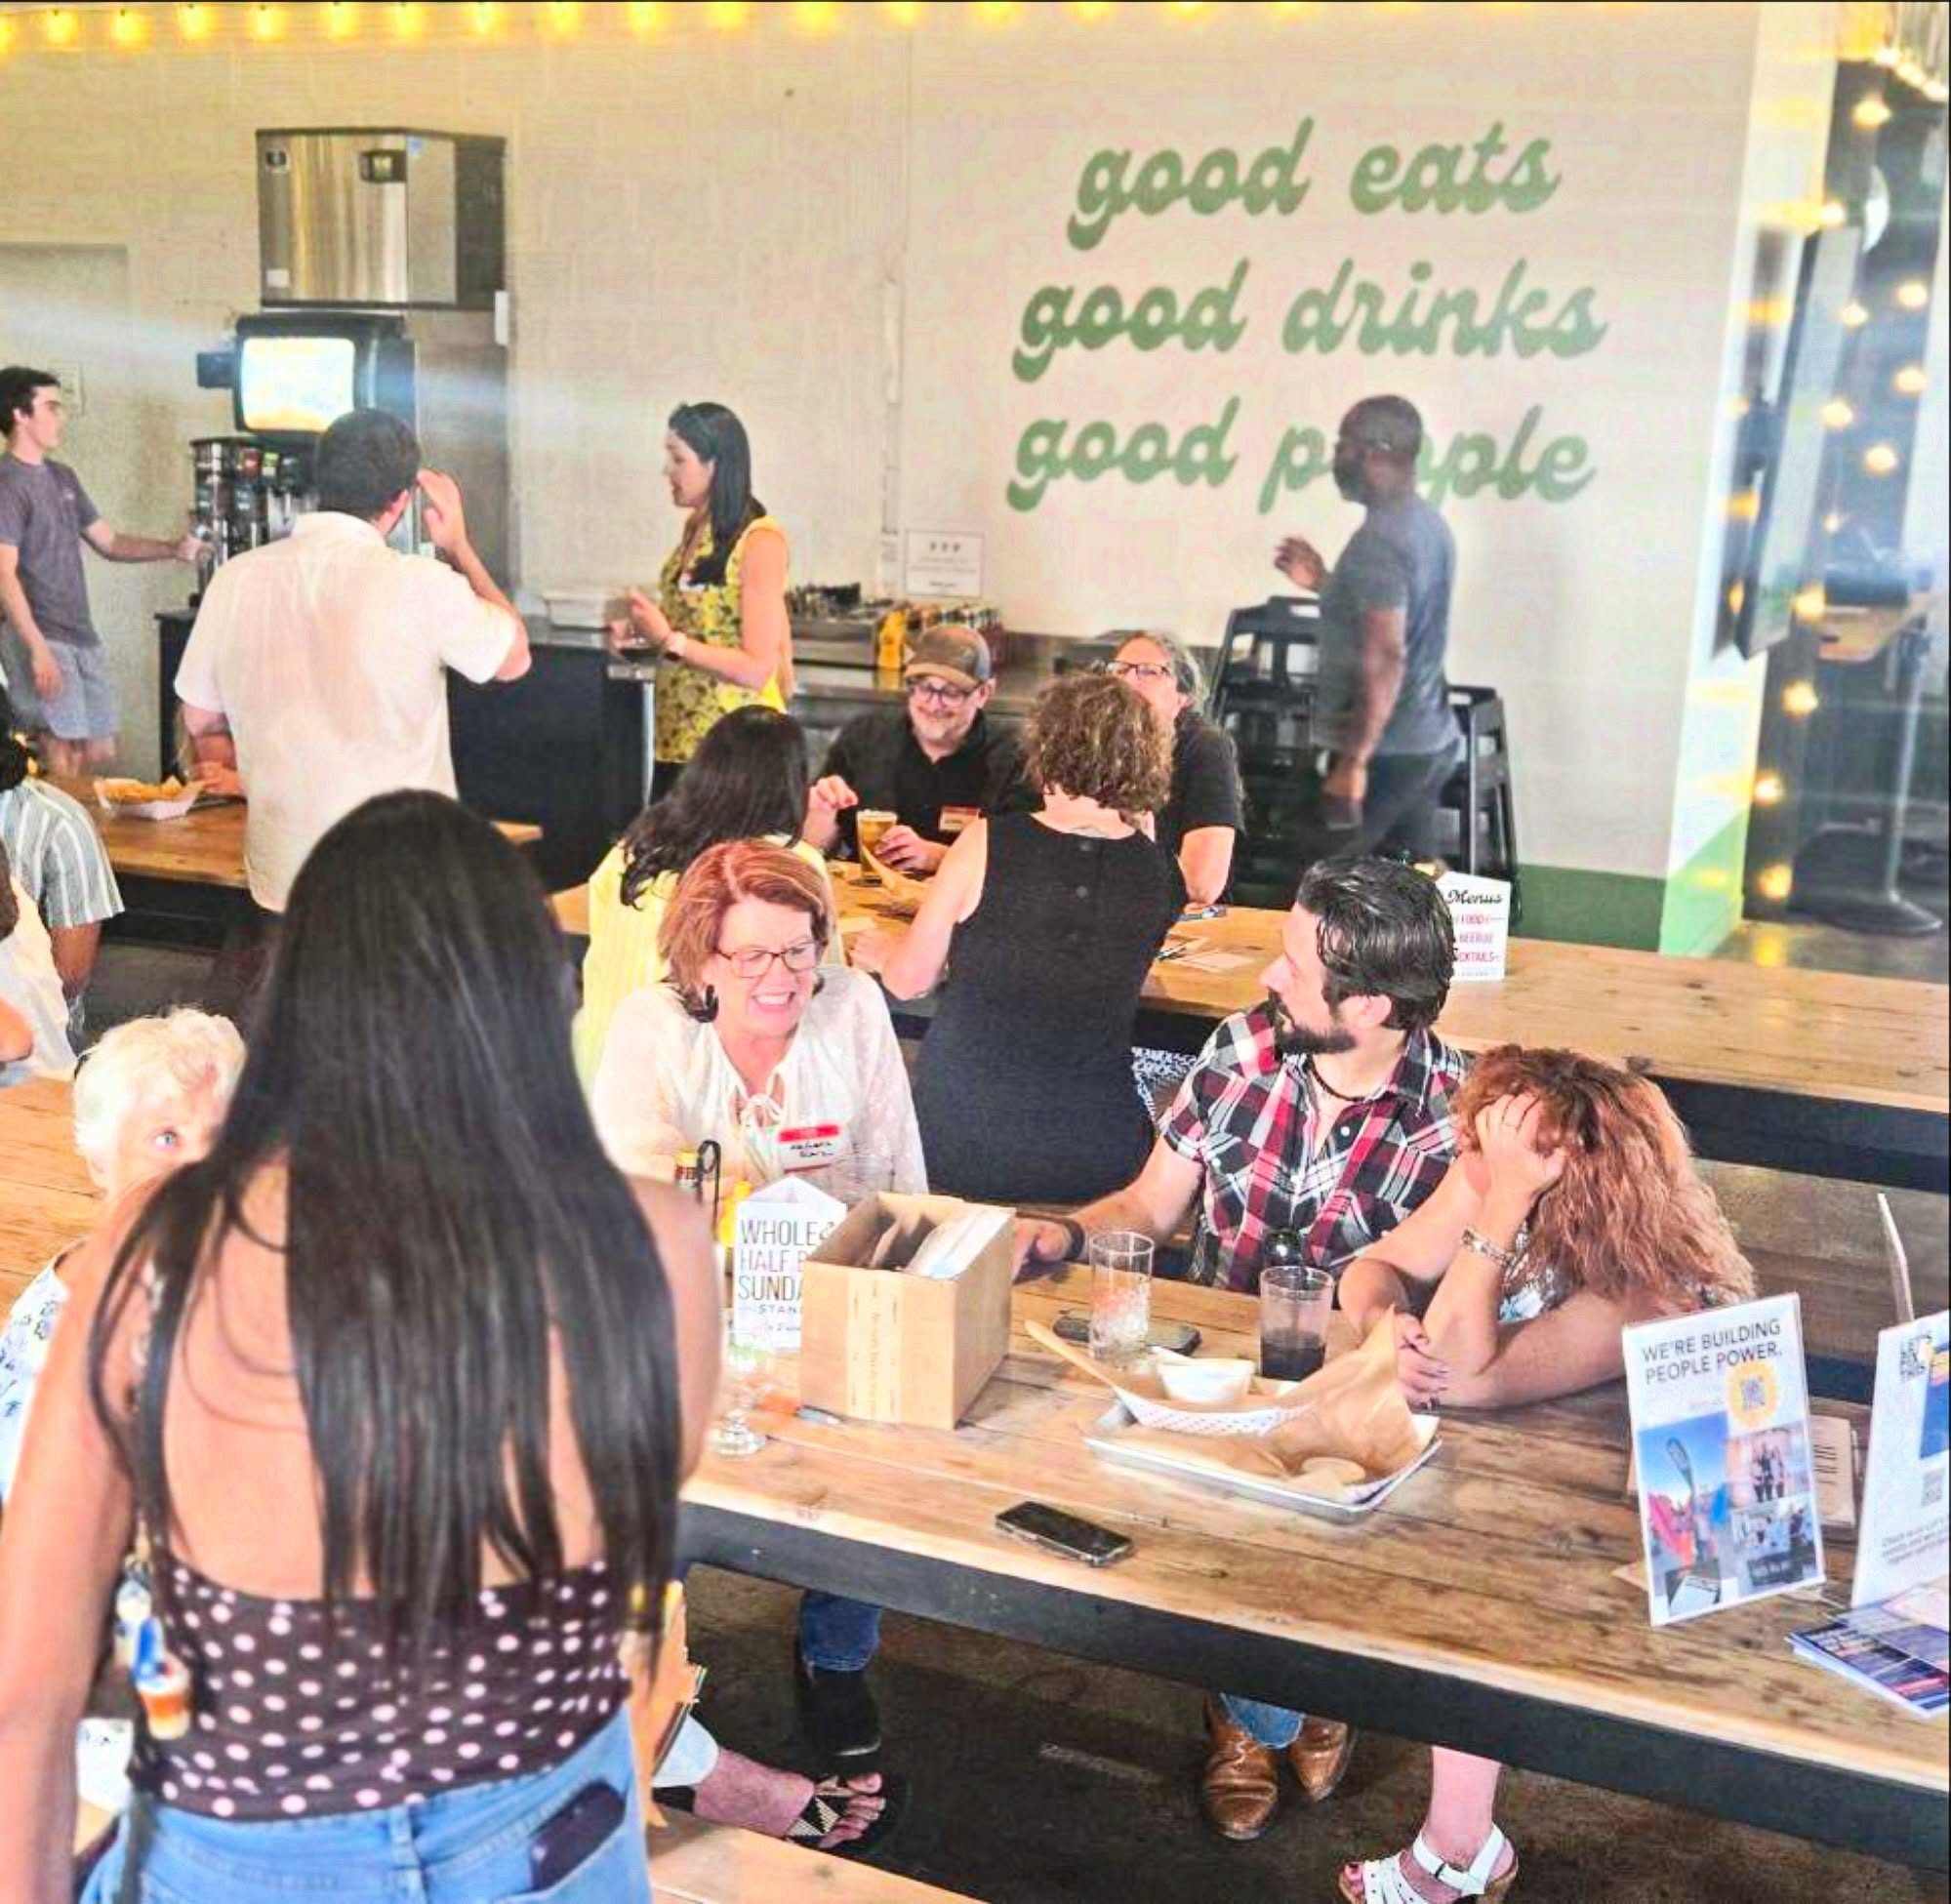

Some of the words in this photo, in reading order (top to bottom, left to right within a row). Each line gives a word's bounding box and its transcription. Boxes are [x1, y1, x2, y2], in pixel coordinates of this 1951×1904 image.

[1067, 116, 1315, 251] good
[1349, 122, 1562, 215] eats
[1011, 259, 1250, 384] good
[1281, 259, 1609, 358] drinks
[1006, 395, 1240, 512] good
[1257, 404, 1598, 515] pple
[1445, 889, 1503, 905] Menus
[739, 1249, 790, 1273] HALF
[1642, 1336, 1696, 1362] WE'RE
[1701, 1317, 1781, 1350] BUILDING
[1646, 1356, 1713, 1385] PEOPLE
[1717, 1341, 1783, 1370] POWER.
